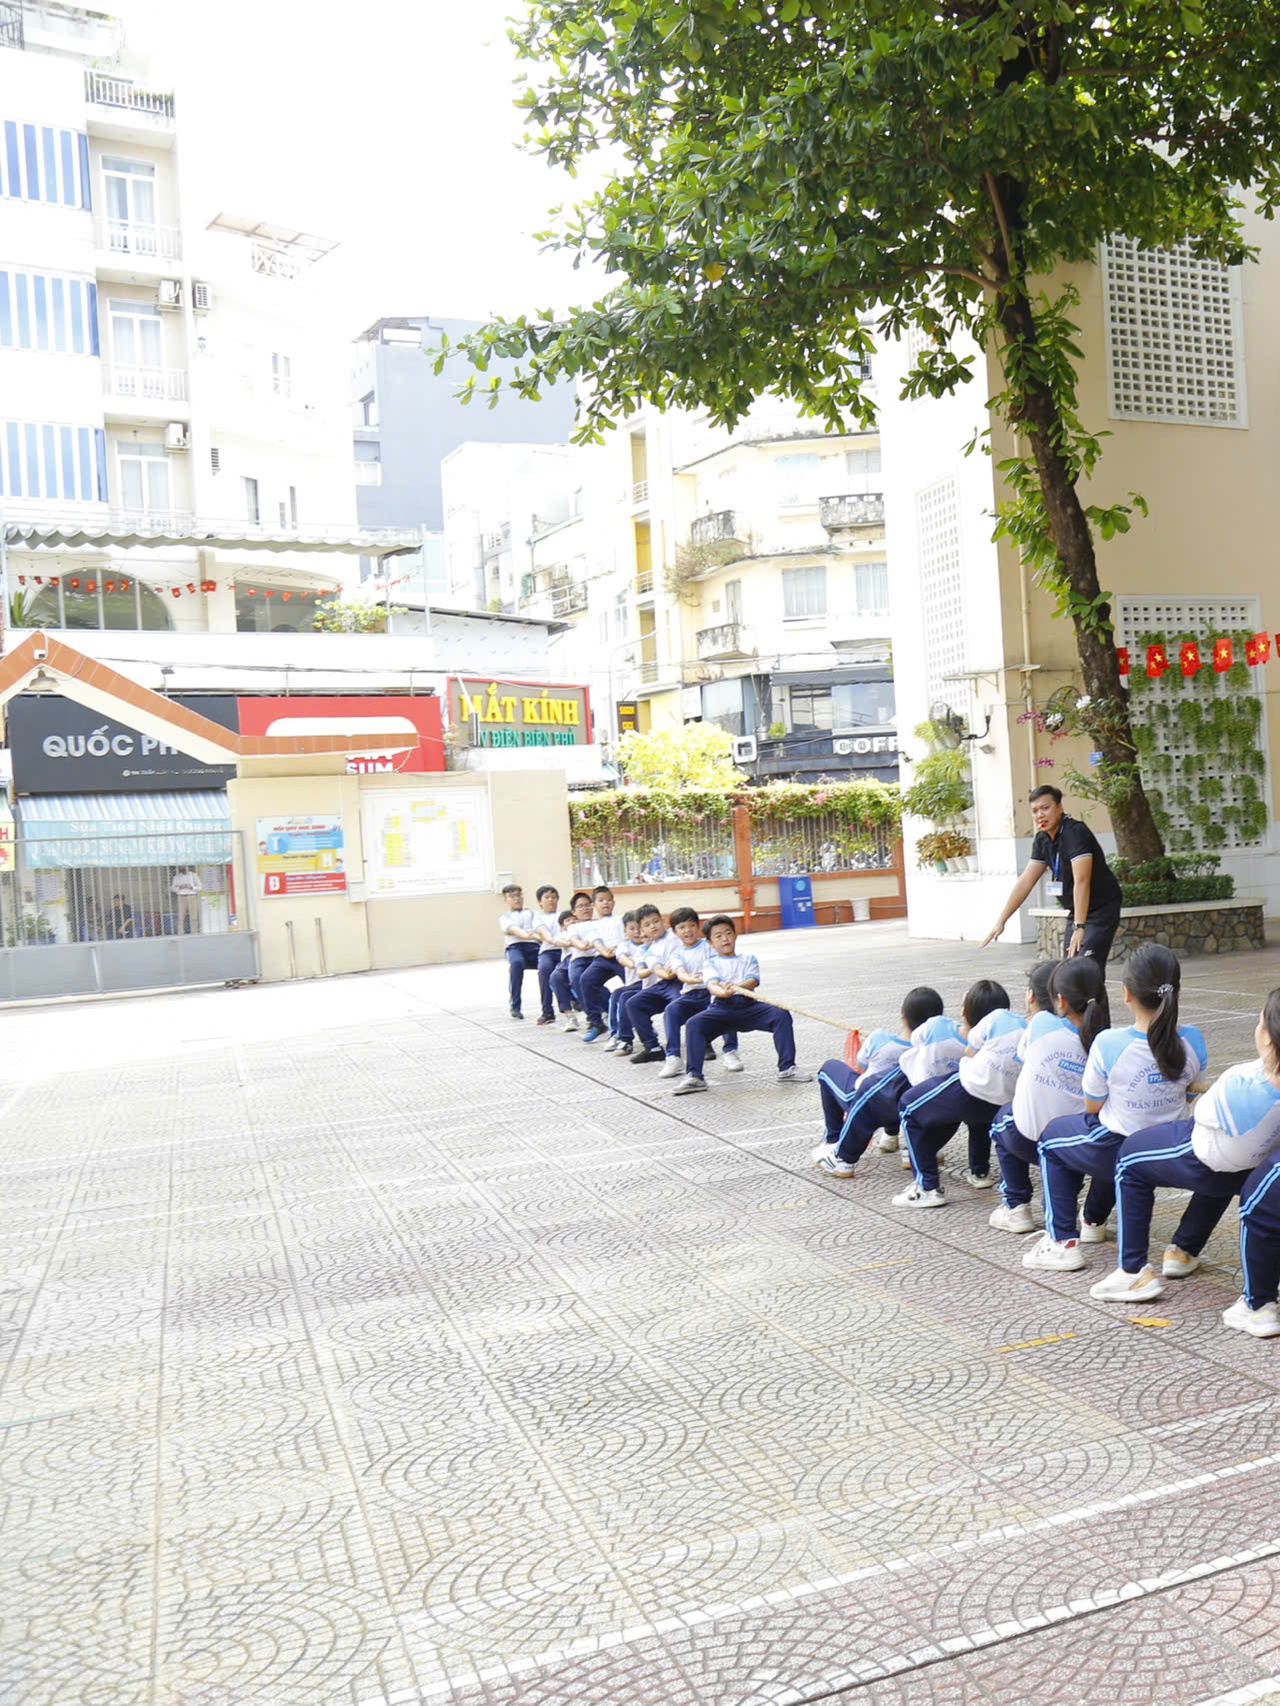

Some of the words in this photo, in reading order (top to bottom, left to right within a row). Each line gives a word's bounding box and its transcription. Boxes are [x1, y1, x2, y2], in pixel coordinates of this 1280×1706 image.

[522, 689, 580, 725] KÍNH
[42, 724, 134, 758] QUỐC
[141, 735, 178, 756] PH
